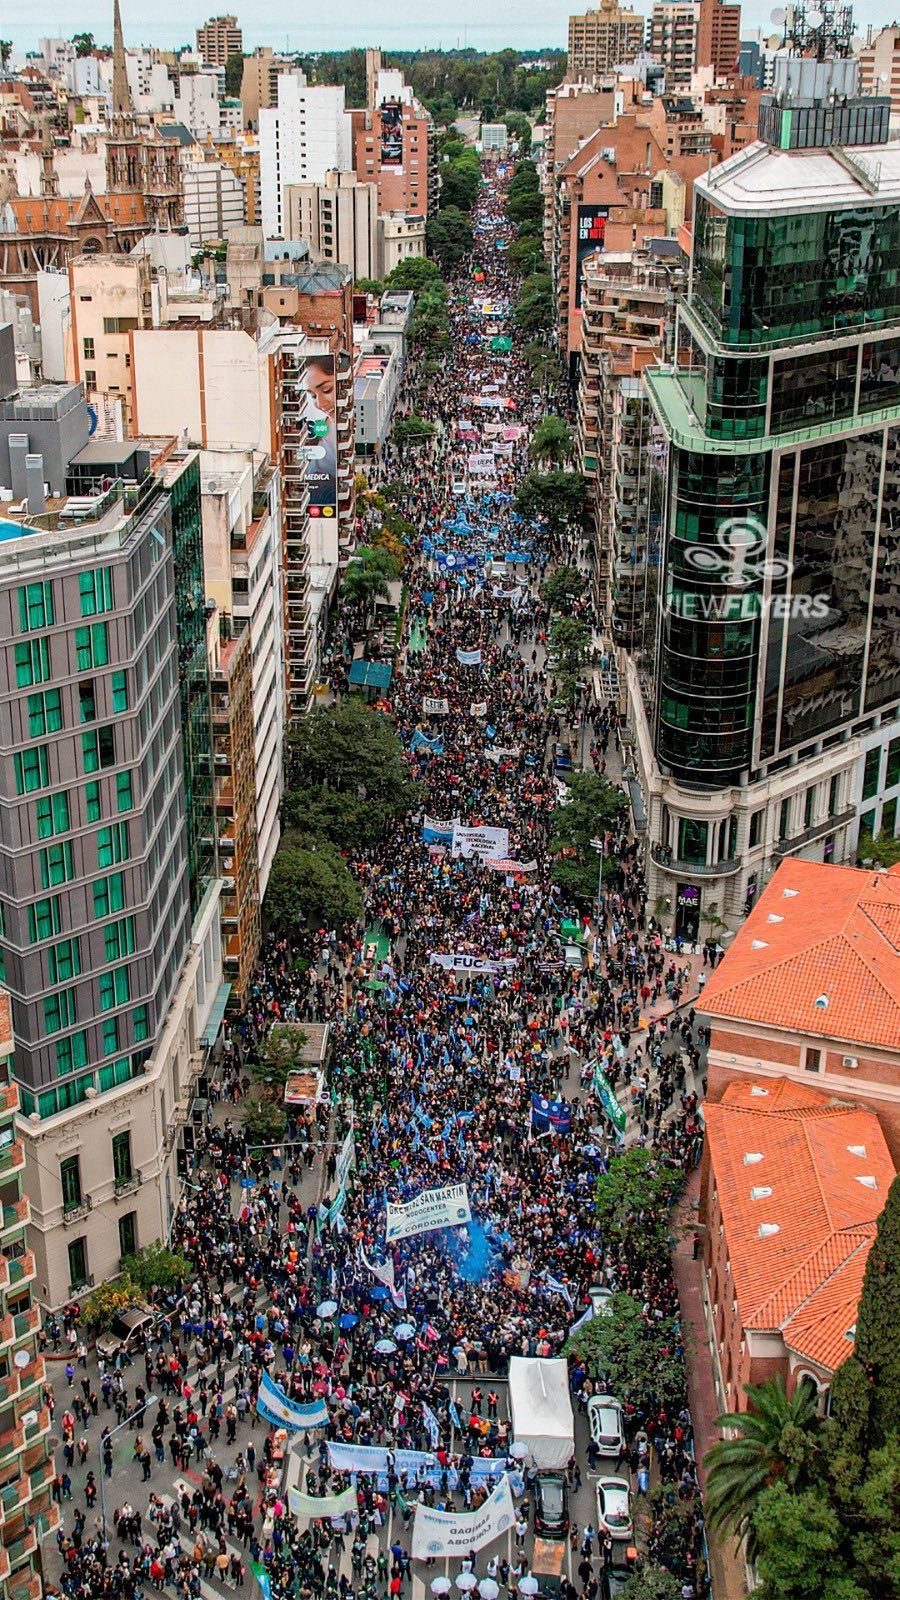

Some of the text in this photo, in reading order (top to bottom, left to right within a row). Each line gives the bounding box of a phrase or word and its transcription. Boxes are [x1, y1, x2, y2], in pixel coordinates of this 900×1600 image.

[580, 218, 592, 228] LOS
[580, 229, 588, 239] EN
[678, 896, 699, 905] MAE
[453, 957, 483, 968] FUC
[420, 1192, 435, 1206] SAN
